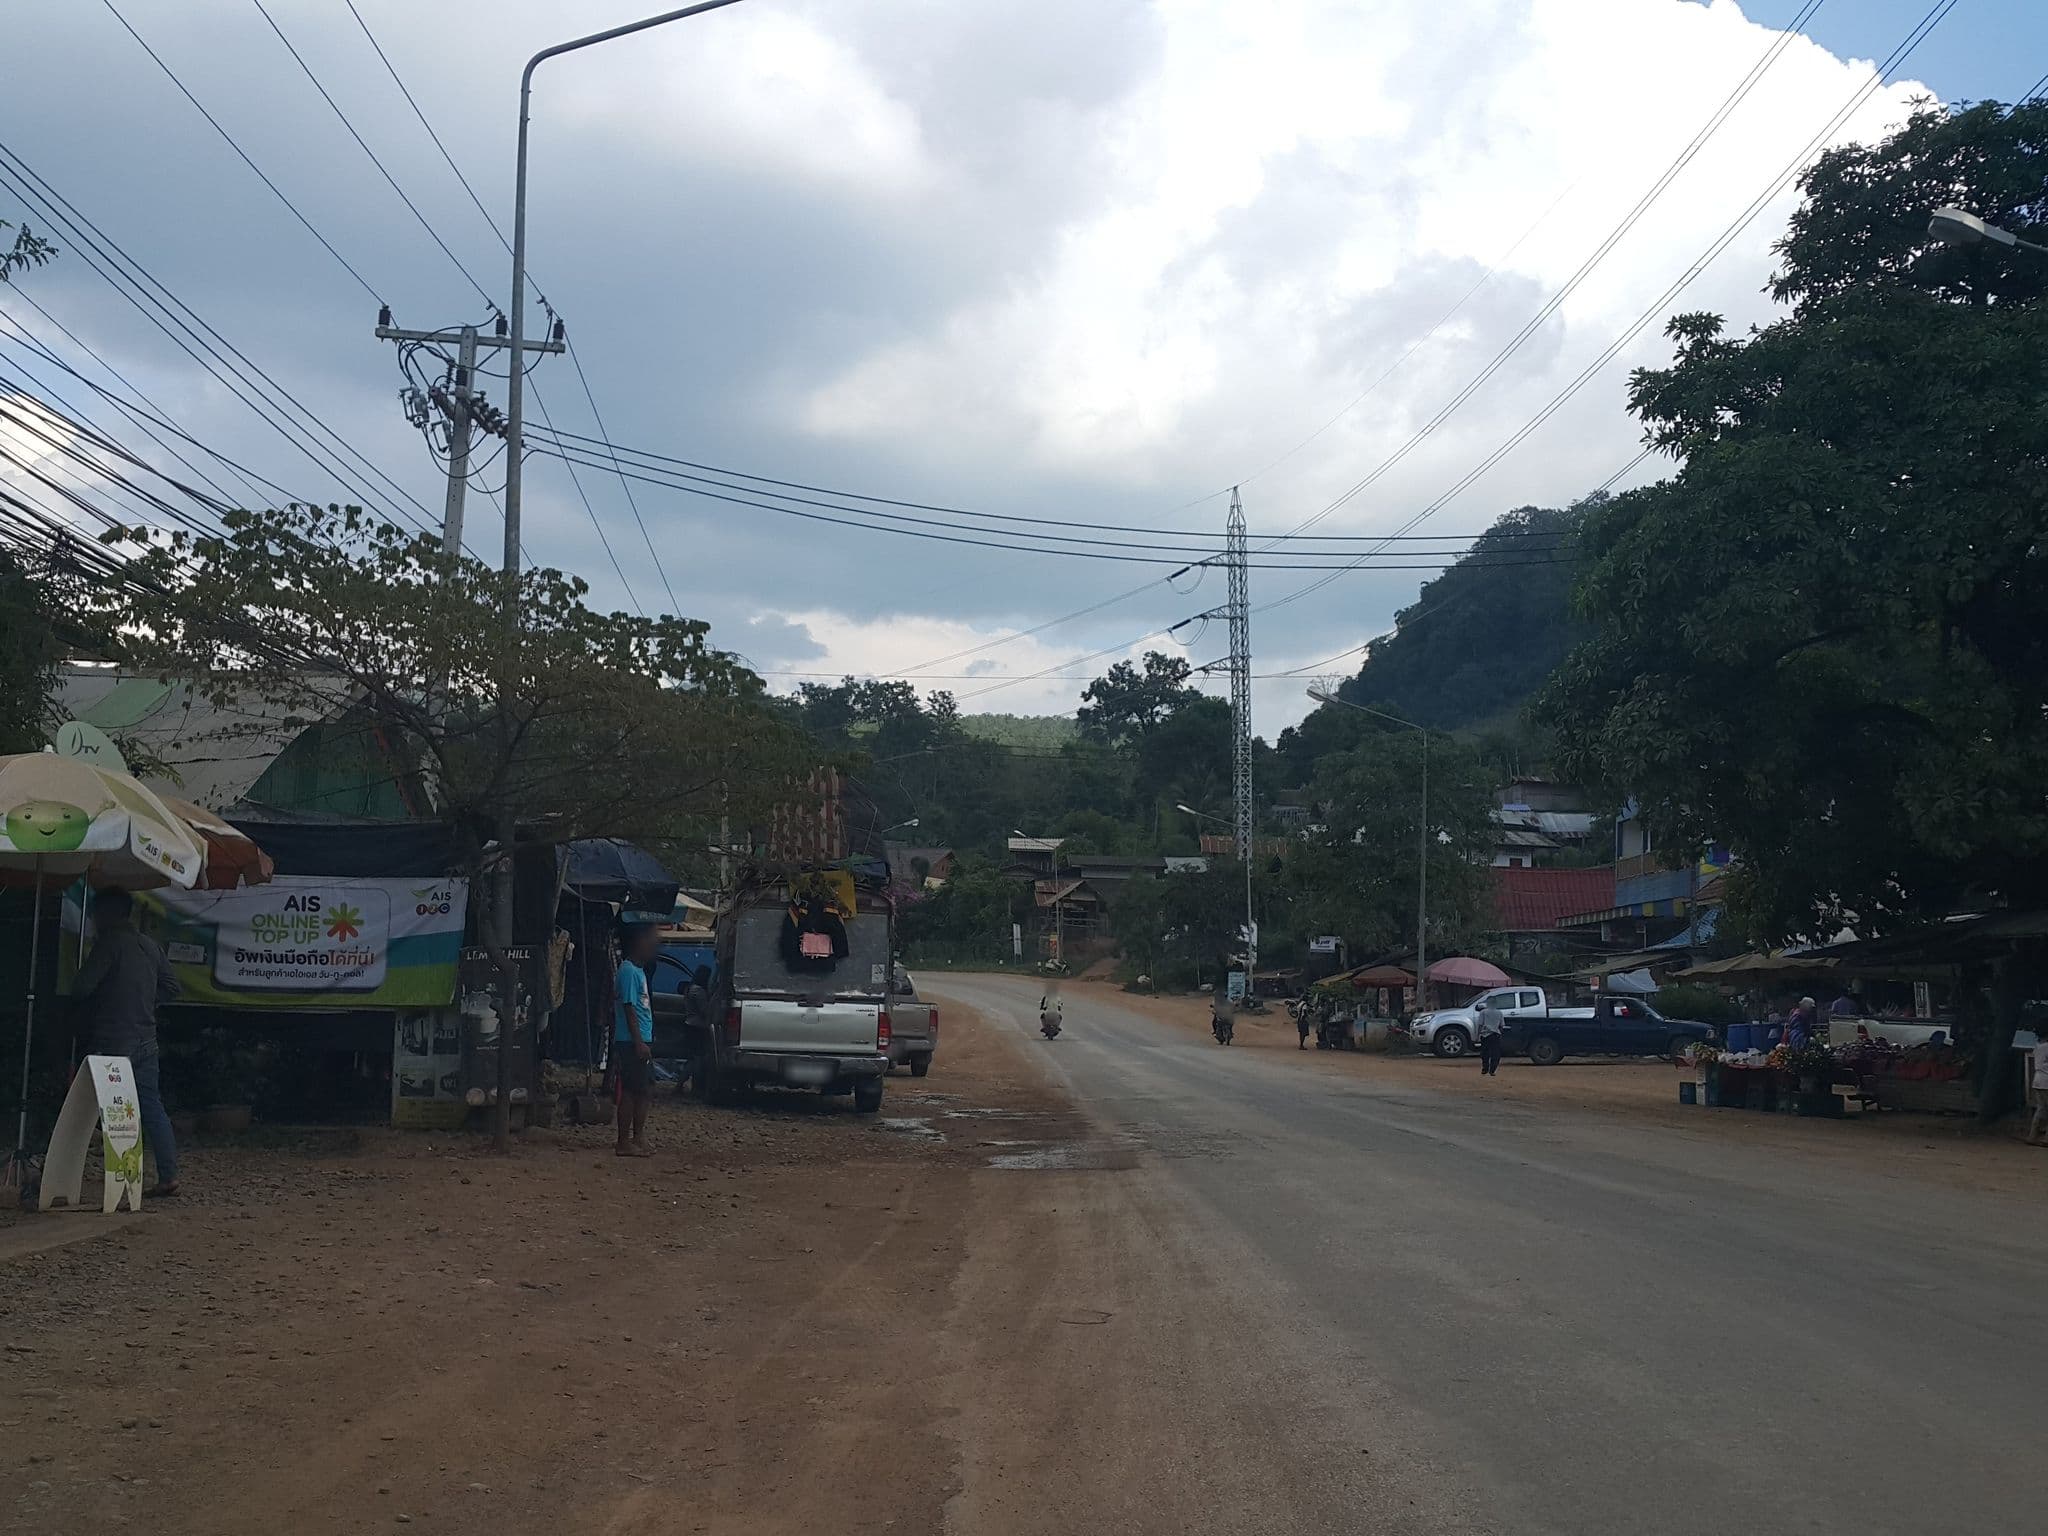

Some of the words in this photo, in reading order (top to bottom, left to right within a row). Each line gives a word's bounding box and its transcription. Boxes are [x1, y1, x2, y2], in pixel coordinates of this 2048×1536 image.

[145, 843, 159, 856] AIS
[430, 891, 452, 901] AIS
[283, 894, 321, 912] AIS
[251, 913, 320, 929] ONLINE
[252, 929, 289, 944] TOP
[293, 929, 320, 945] UP
[507, 949, 531, 960] HILL
[113, 1096, 123, 1105] AIS
